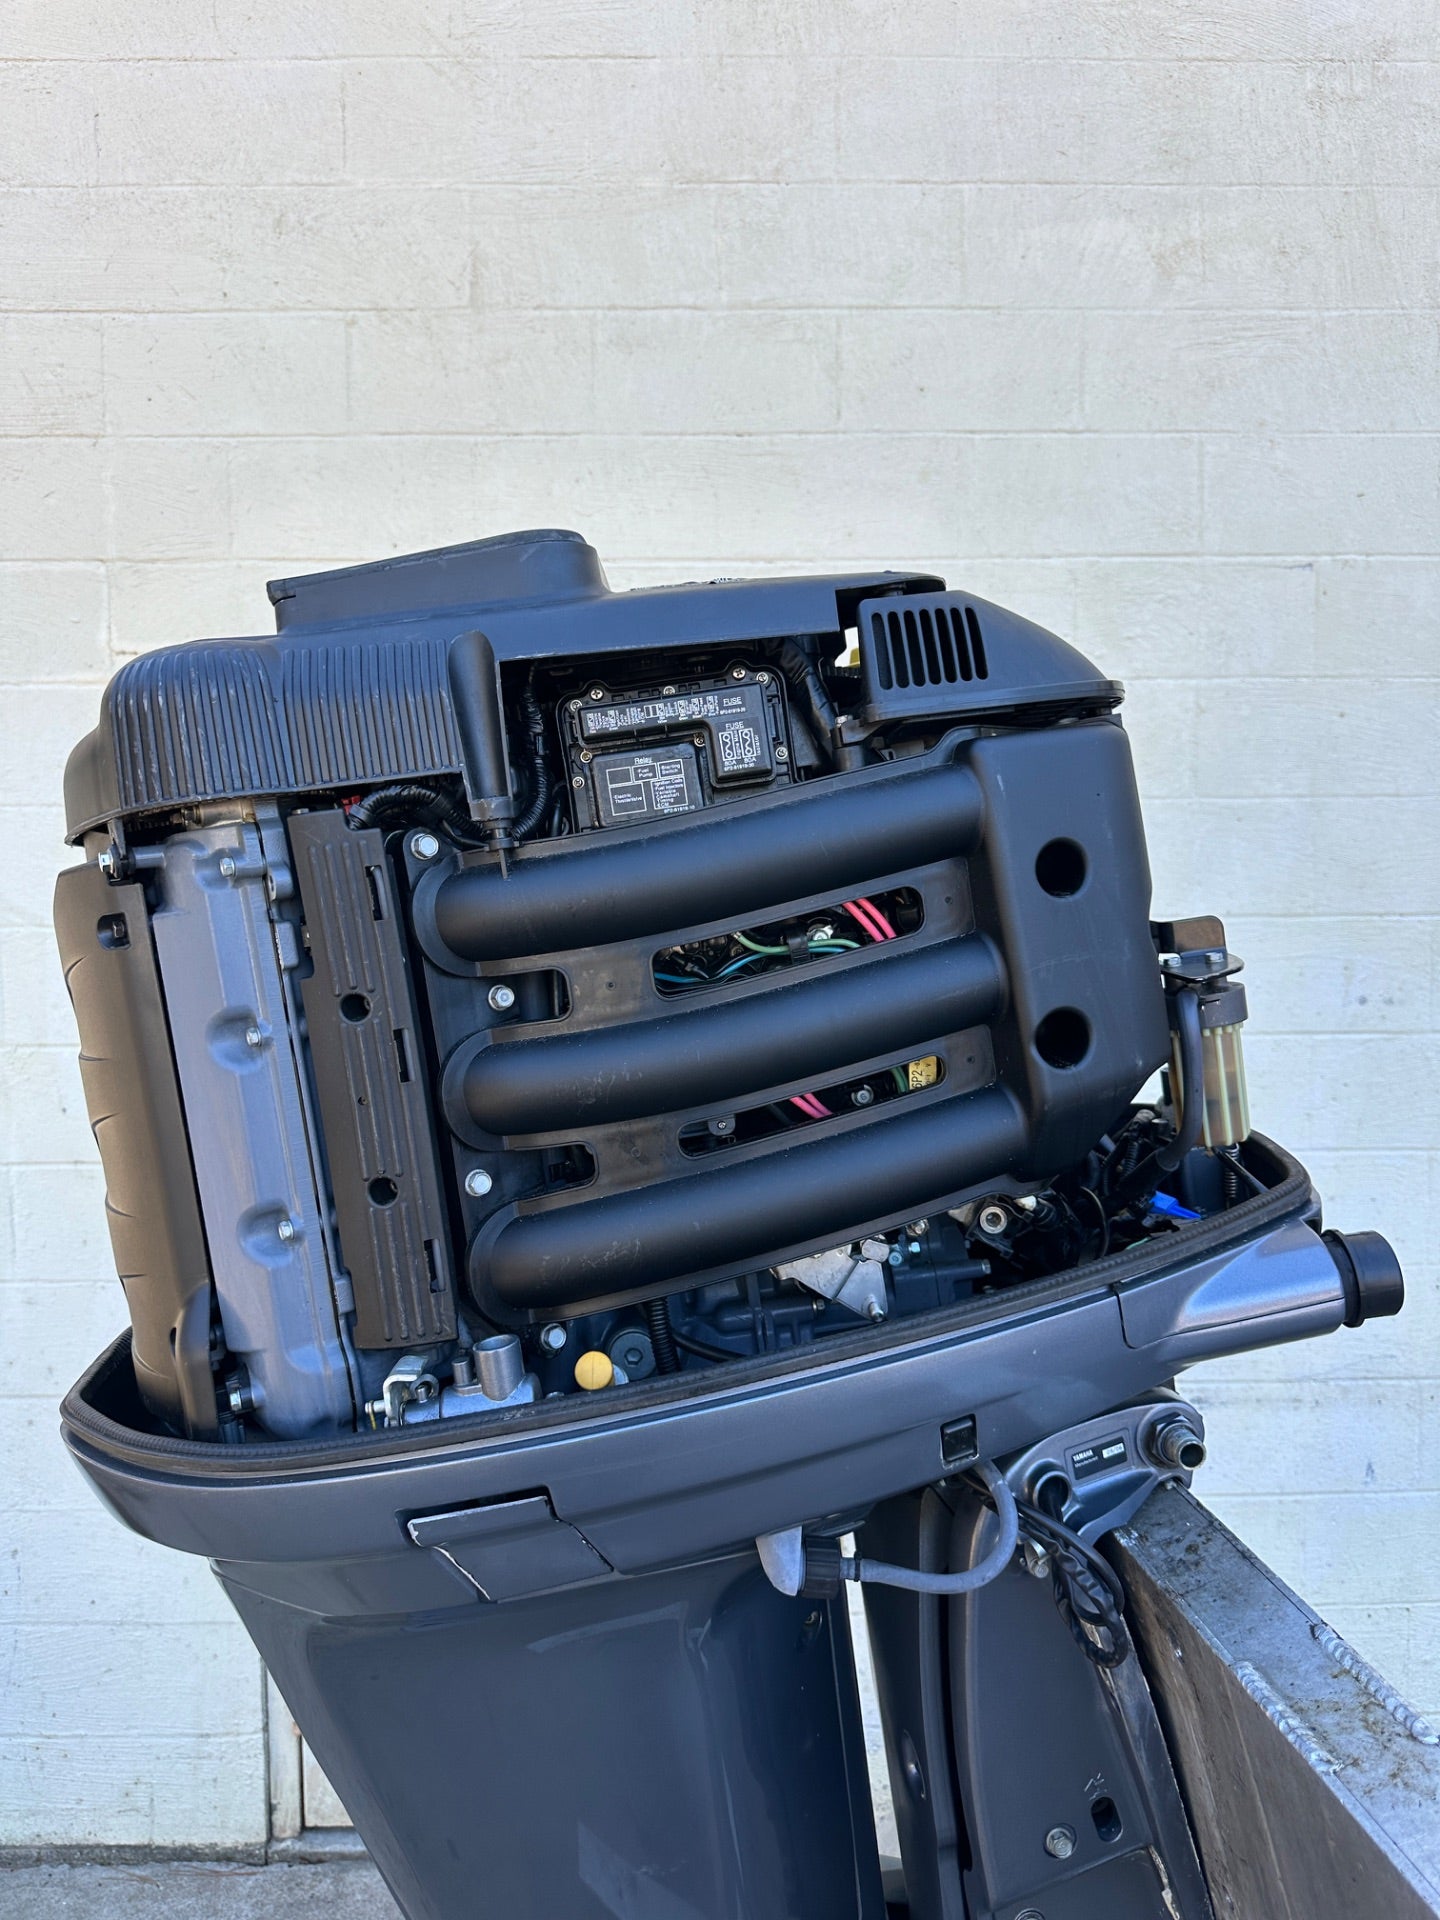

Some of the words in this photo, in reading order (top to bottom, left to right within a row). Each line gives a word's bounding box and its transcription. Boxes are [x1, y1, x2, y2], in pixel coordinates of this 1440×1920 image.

[723, 697, 742, 705] FUSE
[726, 721, 744, 730] FUSE
[634, 757, 652, 765] Relay
[1072, 1449, 1094, 1461] YAMAHA
